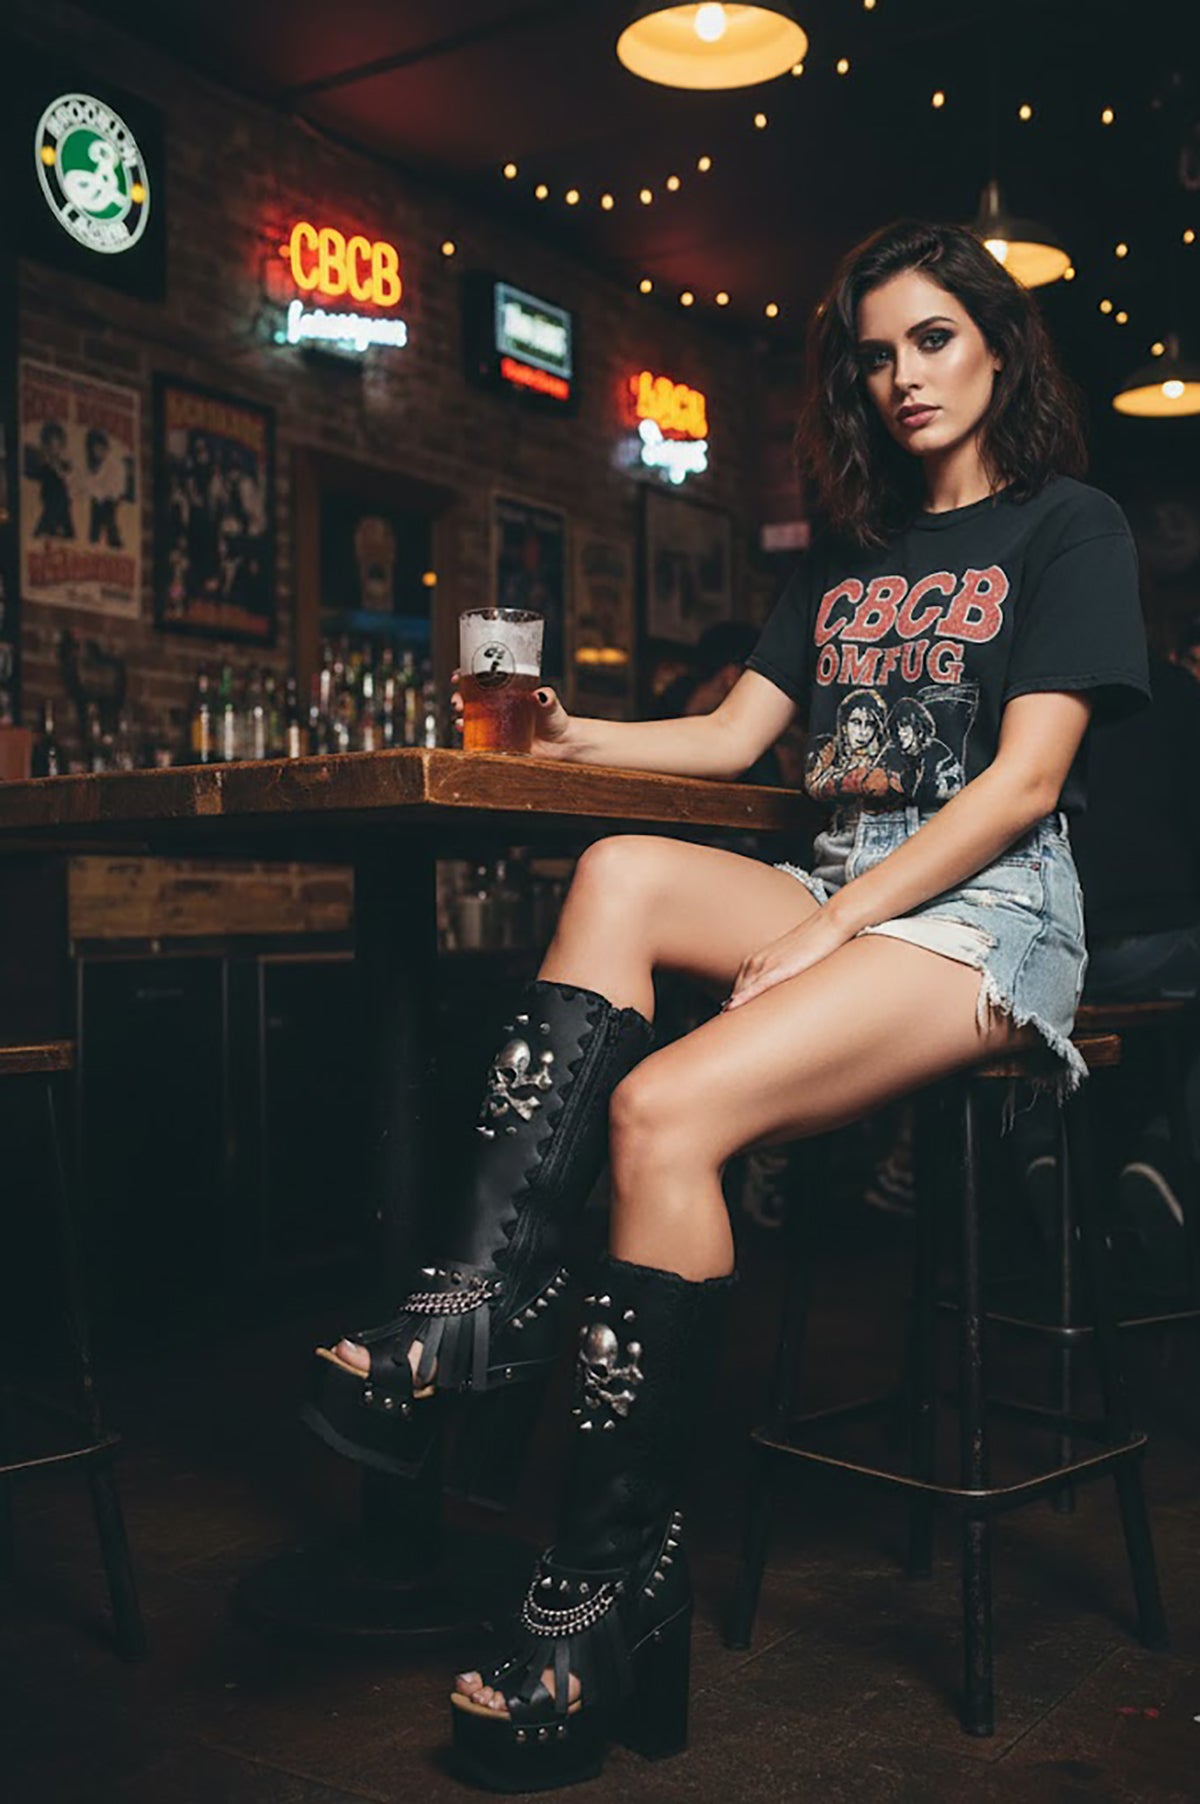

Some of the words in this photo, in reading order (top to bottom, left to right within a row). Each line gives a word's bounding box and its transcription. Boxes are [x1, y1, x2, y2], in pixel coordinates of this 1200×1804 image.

[290, 221, 402, 307] CBCB
[814, 565, 1009, 647] CBCB
[816, 639, 965, 686] OMFUG
